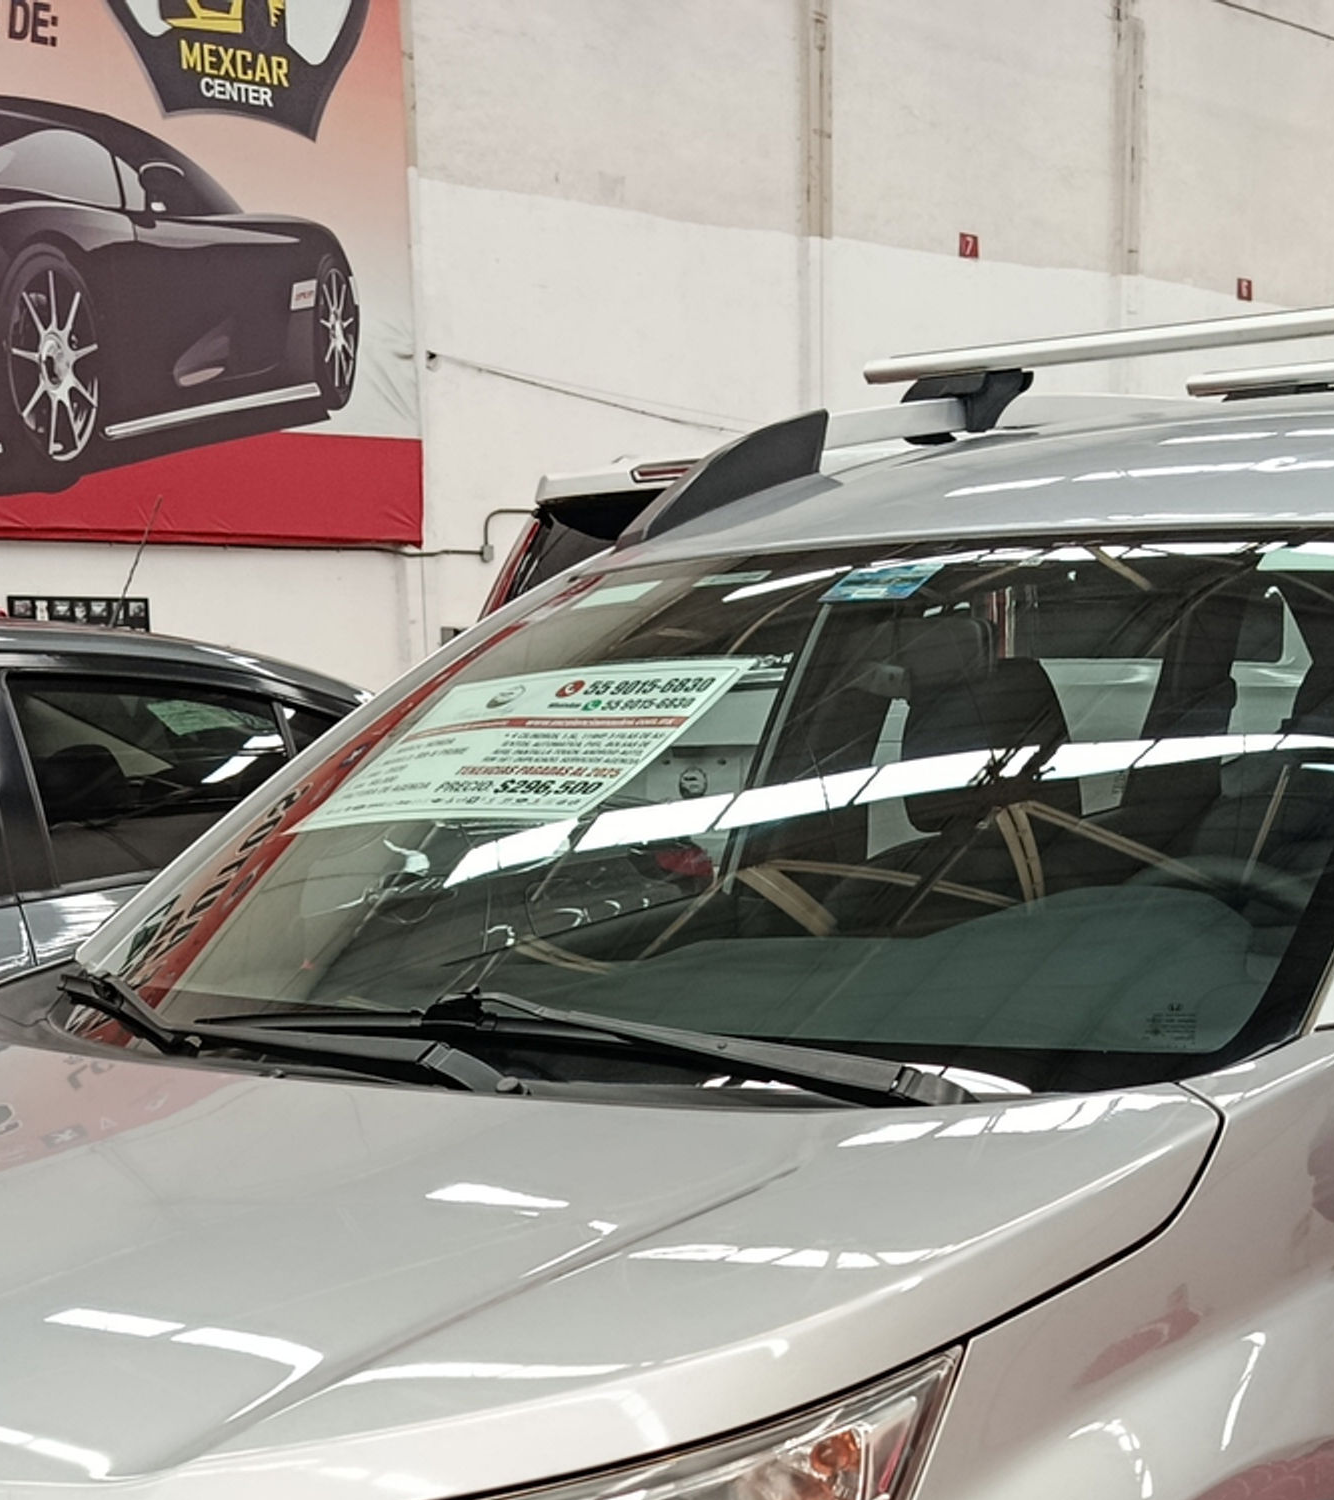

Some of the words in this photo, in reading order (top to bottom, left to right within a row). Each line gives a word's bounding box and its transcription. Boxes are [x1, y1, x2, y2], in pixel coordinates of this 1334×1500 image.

[8, 0, 58, 47] DE:
[180, 39, 290, 87] MEXCAR
[200, 77, 274, 107] CENTER
[583, 680, 610, 696] 55
[611, 677, 716, 696] 9015-6830
[494, 778, 604, 797] $296,500
